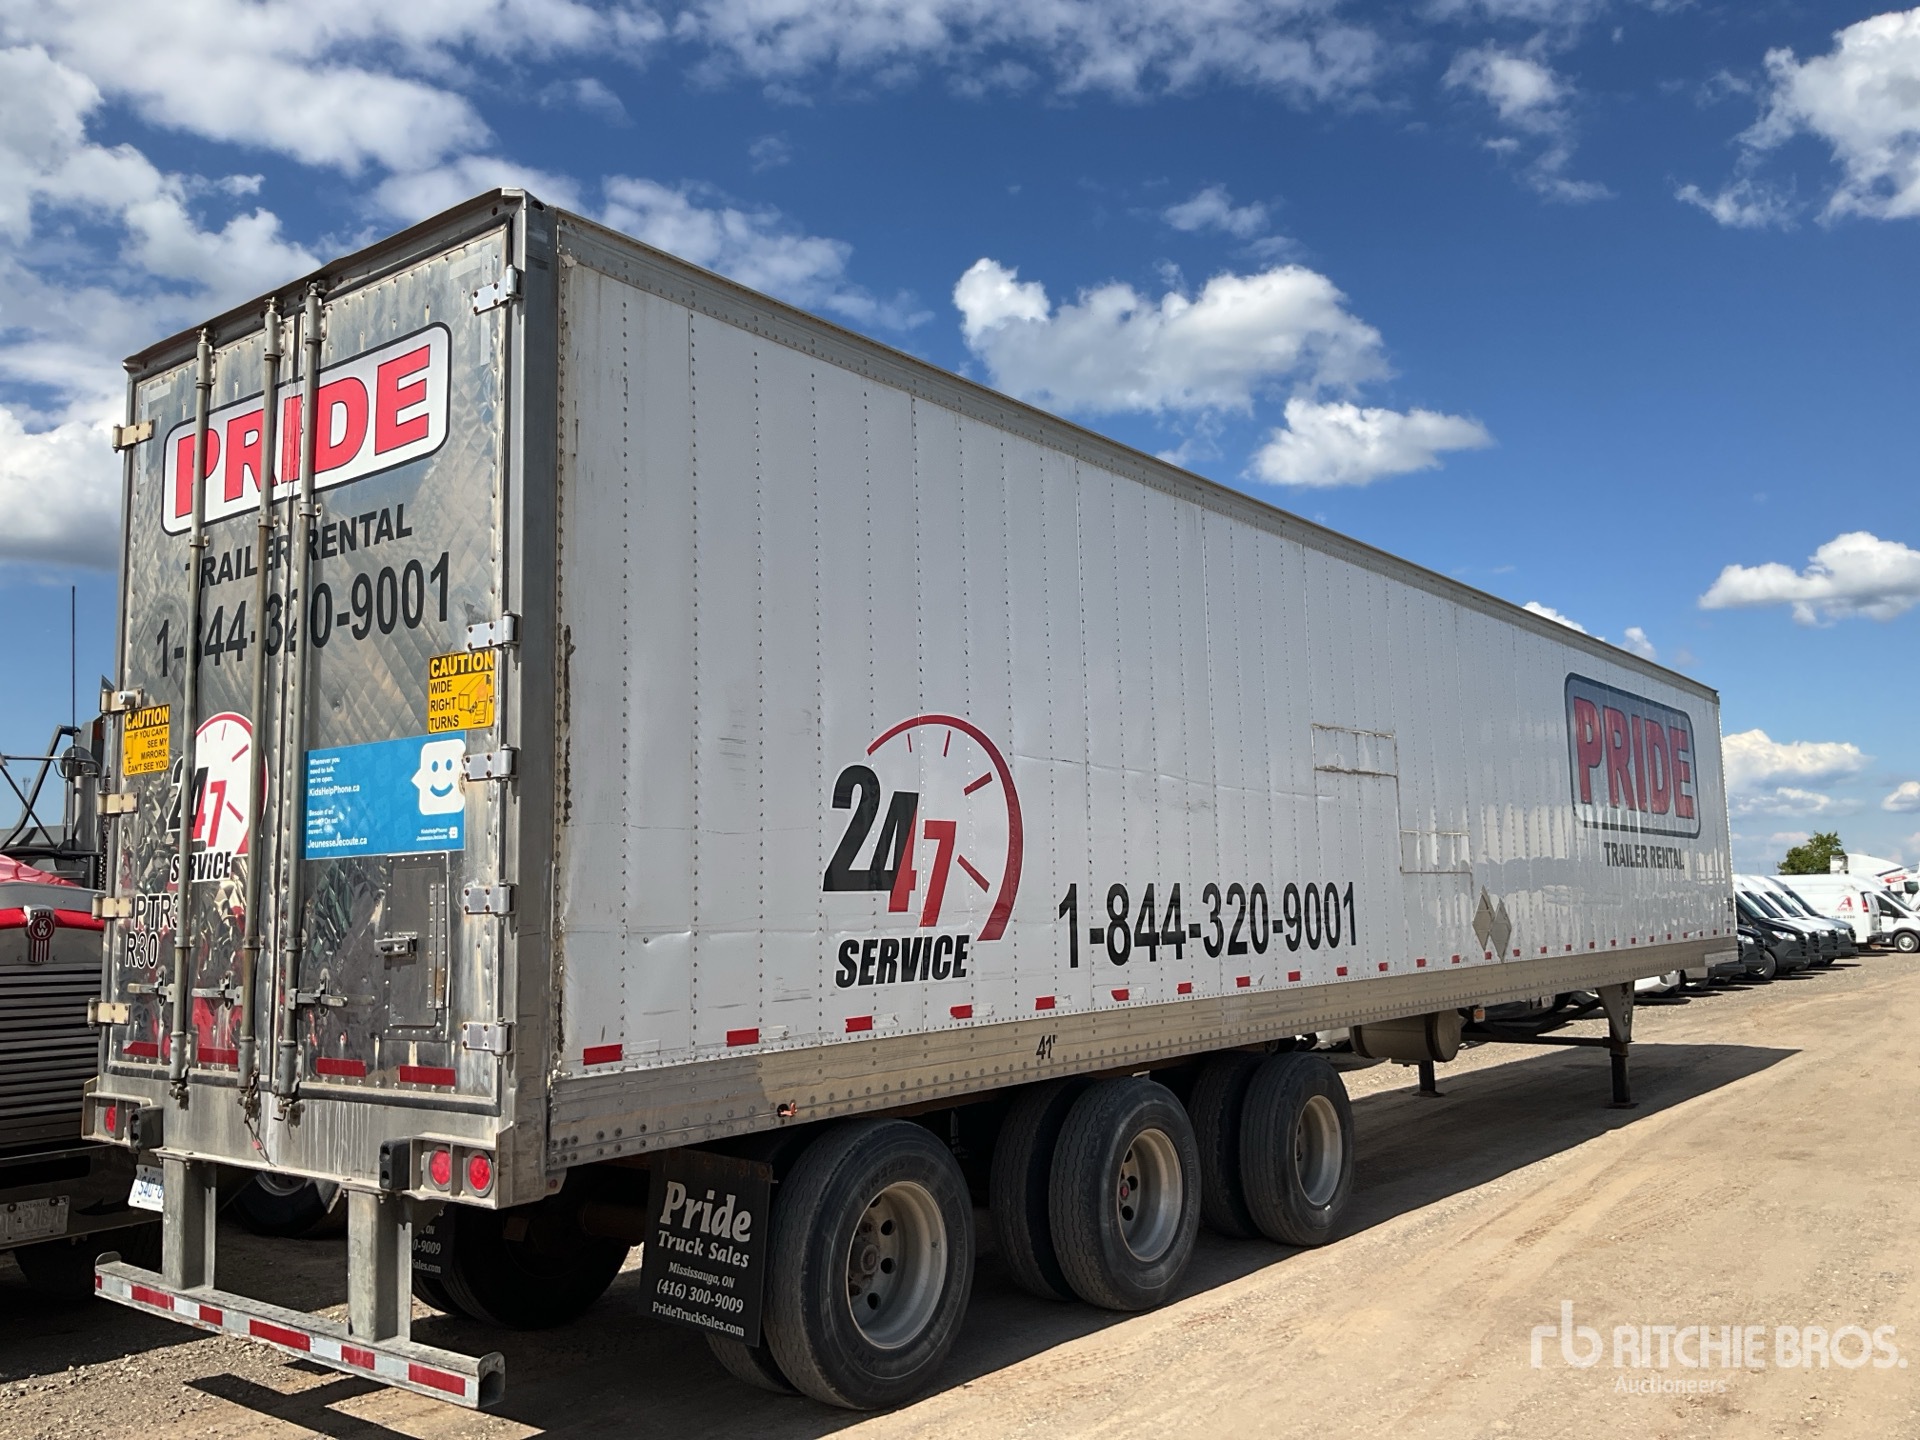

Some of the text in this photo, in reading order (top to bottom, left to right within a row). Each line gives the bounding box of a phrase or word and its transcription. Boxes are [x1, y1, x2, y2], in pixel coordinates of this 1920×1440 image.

[175, 344, 431, 518] PRIDE
[185, 503, 413, 592] RAILER RENTAL
[156, 551, 450, 677] 1-44-30-9001
[430, 650, 494, 678] CAUTION
[430, 680, 453, 695] WIDE
[125, 706, 169, 730] CAUTION
[430, 697, 457, 712] RIGHT
[140, 729, 151, 739] YOU
[151, 726, 168, 737] CAN'T
[430, 714, 459, 730] TURNS
[147, 737, 168, 749] SEE MY
[1573, 696, 1695, 820] PRIDE
[143, 761, 154, 771] SEE
[155, 760, 168, 769] YOU
[308, 785, 360, 797] KidsHelpPhone.ca
[170, 851, 232, 882] SRVICE
[1604, 841, 1685, 870] TRAILER RENTAL
[1059, 881, 1356, 969] 1-844-320-9001
[126, 932, 158, 968] R30
[835, 935, 970, 989] SERVICE
[659, 1181, 752, 1243] Pride
[412, 1238, 442, 1255] 0-9009
[658, 1230, 750, 1268] Truck Sales
[668, 1261, 736, 1289] Mississauga, ON
[656, 1278, 744, 1314] (416) 300-9009
[652, 1301, 745, 1337] PrideTruckSales.com
